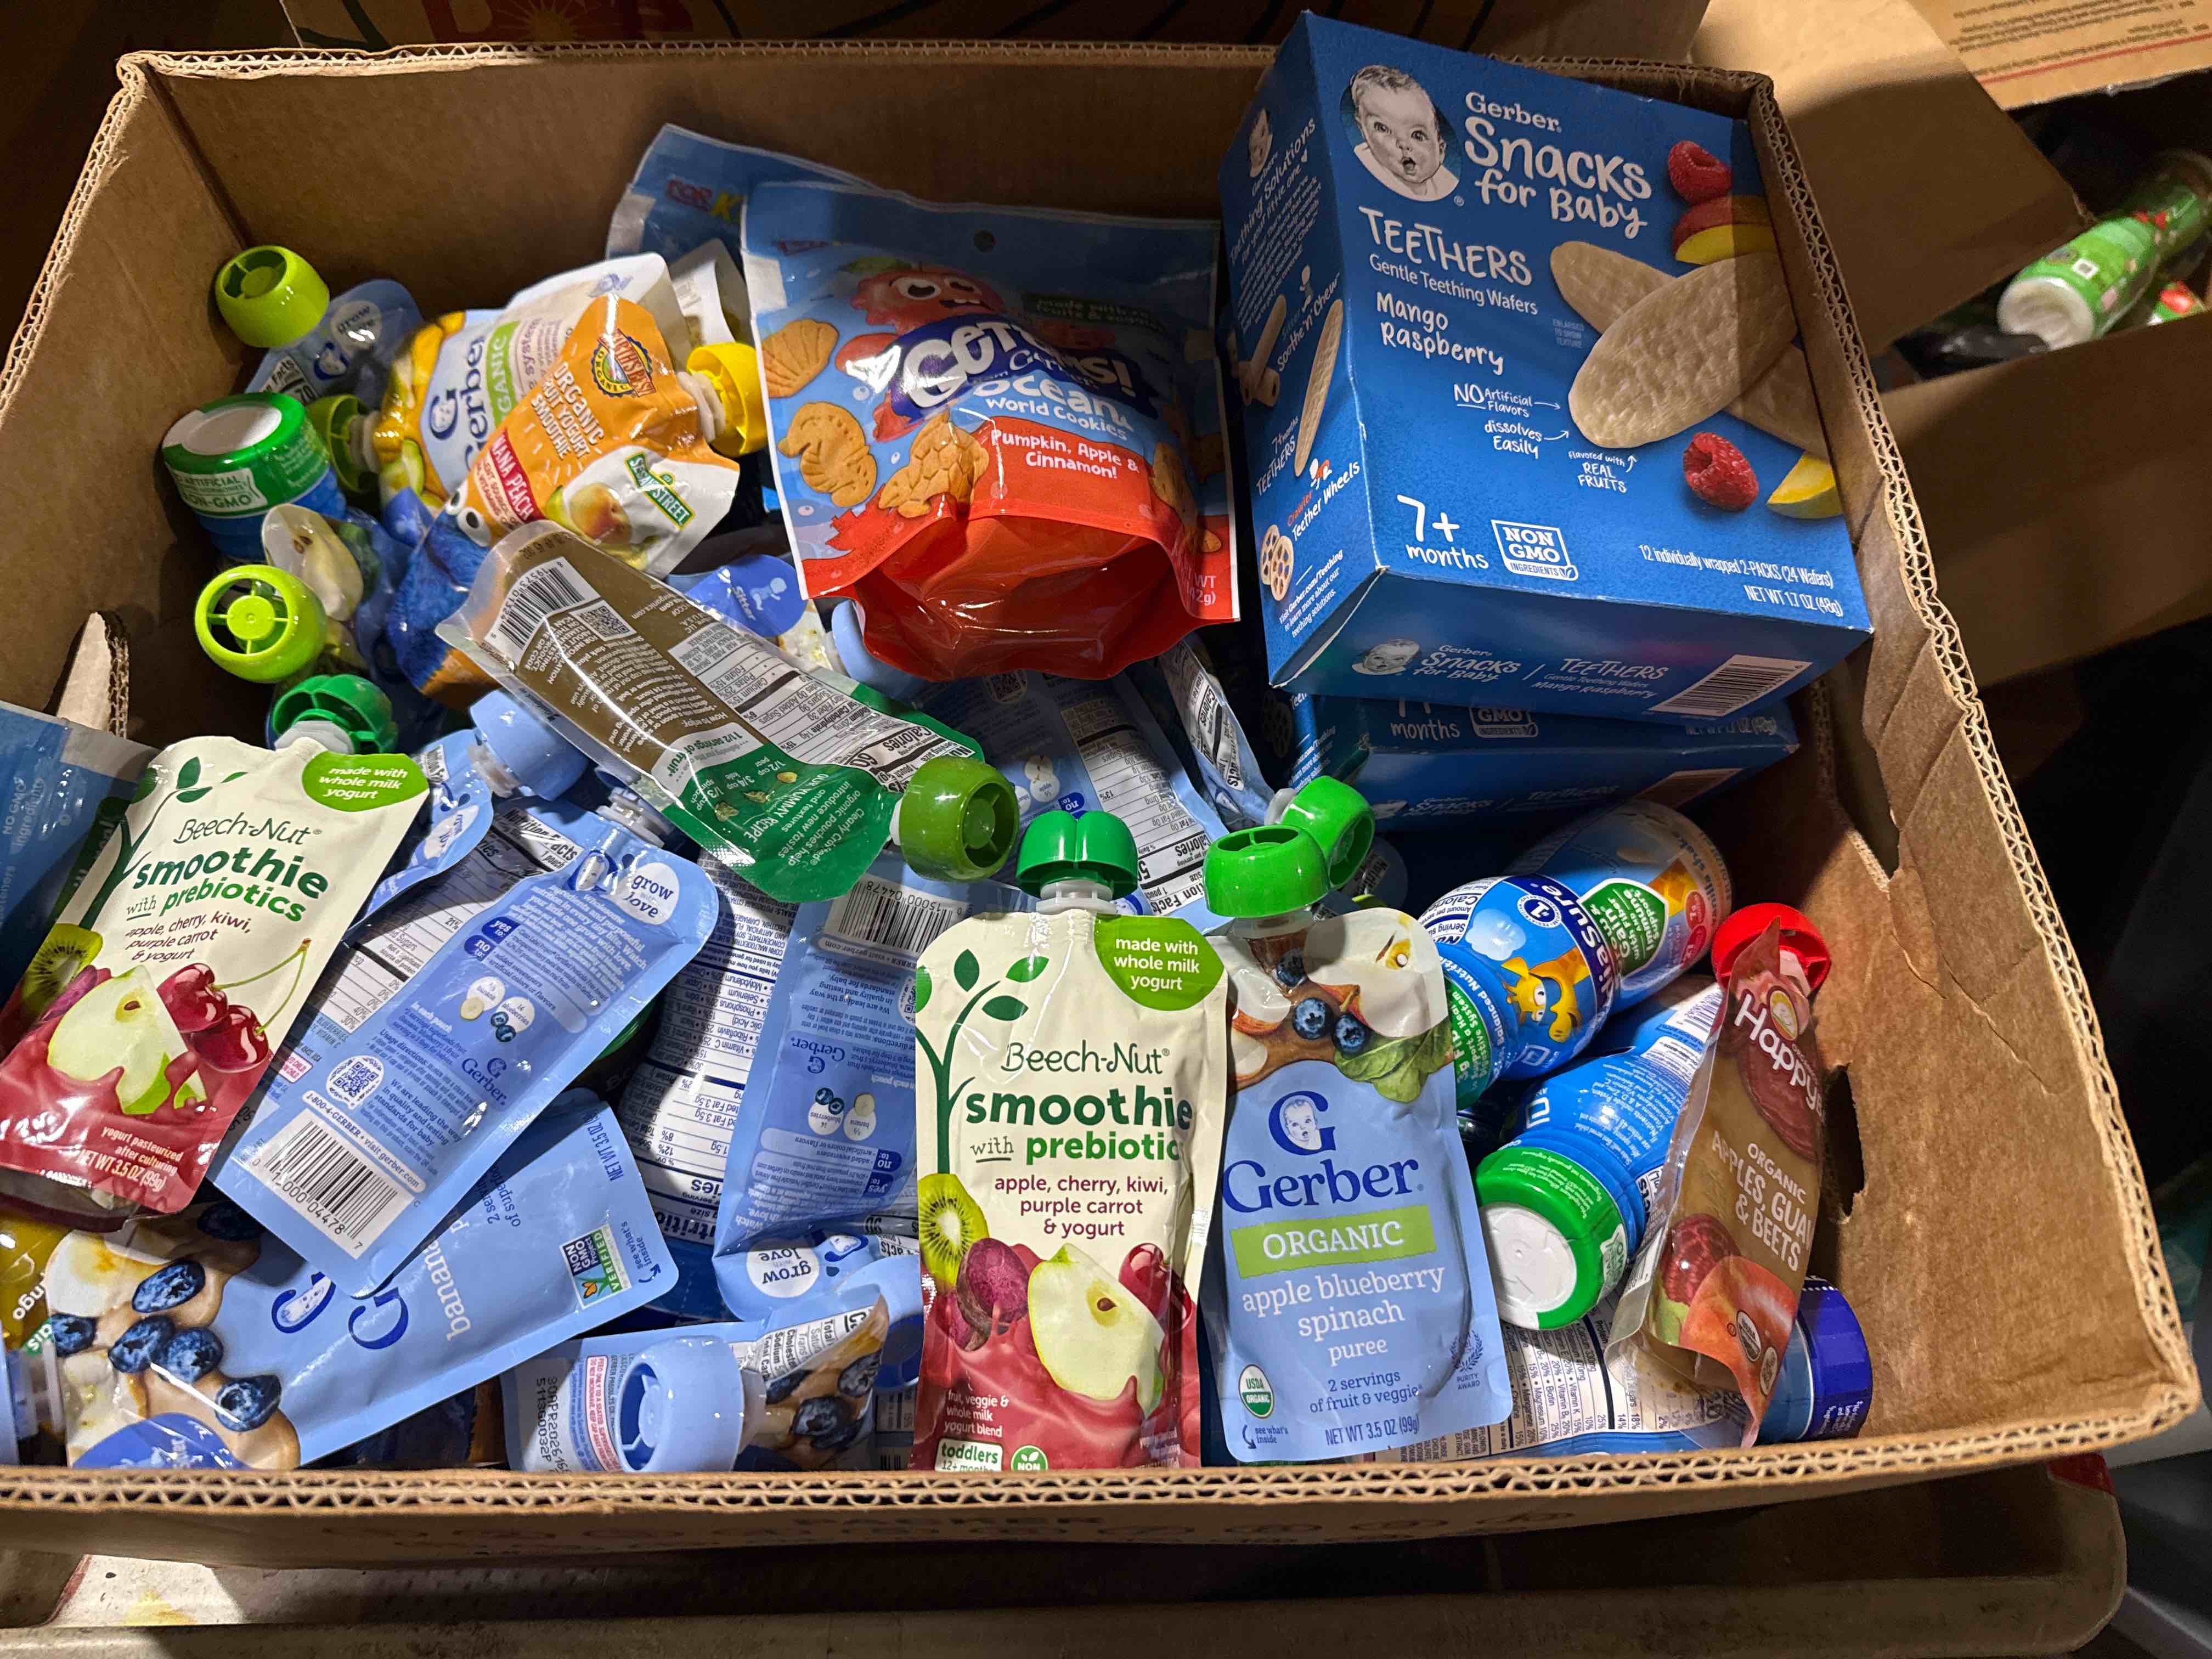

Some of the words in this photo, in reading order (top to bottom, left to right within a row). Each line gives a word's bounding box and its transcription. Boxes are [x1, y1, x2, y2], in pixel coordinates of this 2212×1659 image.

[1475, 167, 1537, 207] for
[1550, 187, 1647, 239] Baby
[1358, 206, 1532, 286] TEETHERS
[1369, 253, 1418, 285] Gentle
[1420, 271, 1484, 307] Teething
[1486, 290, 1538, 315] Wafers
[1376, 292, 1449, 332] Mango
[1380, 320, 1504, 376] Raspberry
[1454, 384, 1485, 404] NO
[1484, 388, 1533, 407] Artificial
[1488, 401, 1530, 417] Flavors
[531, 393, 571, 460] SMOOTHIE
[557, 405, 592, 460] YOGURT
[1053, 406, 1127, 442] Cookies
[1485, 420, 1542, 442] dissolves
[991, 430, 1071, 454] Pumpkin,
[1077, 442, 1121, 467] Apple
[1126, 458, 1140, 473] &
[1493, 436, 1539, 459] Easily
[1568, 451, 1603, 460] flavored
[1605, 456, 1625, 466] with
[1025, 451, 1118, 479] Cinnamon!
[1582, 462, 1616, 479] REAL
[506, 475, 534, 520] PEACH
[1577, 475, 1628, 493] FRUITS
[652, 484, 689, 526] STREET
[1292, 499, 1322, 542] Teether
[1323, 461, 1361, 505] Wheels
[1397, 494, 1460, 543] 7+
[1504, 526, 1555, 548] NON
[1405, 543, 1489, 570] months
[1511, 543, 1561, 564] GMO
[1638, 544, 1654, 561] 12
[1654, 548, 1702, 571] individually
[1703, 557, 1739, 574] wrapped
[1740, 560, 1783, 580] 2-PACKS
[1781, 566, 1799, 583] (24
[1799, 568, 1835, 589] Wafers)
[1510, 562, 1560, 577] INGREDIENTS
[1744, 585, 1768, 602] NET
[1766, 588, 1785, 604] WT
[1784, 591, 1799, 607] 1.7
[1799, 594, 1816, 610] OZ
[1815, 596, 1844, 618] (48g)
[1559, 658, 1670, 681] TEETHERS
[1390, 720, 1460, 742] months
[319, 776, 366, 786] whole
[369, 778, 402, 789] milk
[330, 767, 370, 776] made
[373, 768, 408, 778] with
[324, 788, 377, 800] yogurt
[816, 781, 853, 815] introduce
[834, 789, 861, 817] organic
[802, 814, 820, 832] new
[805, 814, 837, 848] pouches
[839, 808, 865, 835] Clearly
[778, 831, 805, 859] tastes
[788, 849, 811, 866] help
[132, 846, 330, 900] smoothie
[127, 898, 157, 916] with
[160, 878, 308, 923] prebiotics
[630, 874, 675, 901] grow
[623, 891, 659, 918] love
[168, 913, 207, 935] cherry,
[210, 911, 252, 935] kiwi,
[490, 918, 512, 932] yes
[127, 935, 175, 951] purple
[177, 928, 219, 948] carrot
[475, 939, 492, 952] no
[1115, 938, 1161, 953] made
[1164, 939, 1199, 955] with
[131, 950, 145, 962] &
[143, 948, 195, 963] yogurt
[1114, 955, 1164, 970] whole
[1167, 958, 1200, 974] milk
[1130, 973, 1183, 991] yogurt
[1477, 990, 1506, 1046] Balanced
[965, 1085, 1193, 1131] smoothie
[101, 1126, 133, 1143] yogurt
[131, 1136, 184, 1162] pasteurized
[304, 1092, 361, 1138] 1-800-4-GERBER
[364, 1138, 382, 1156] visit
[378, 1150, 420, 1188] gerber.com
[970, 1136, 1014, 1156] with
[1026, 1130, 1186, 1166] prebiotic
[78, 1148, 99, 1169] NET
[95, 1153, 116, 1172] WT
[111, 1159, 131, 1177] 3.5
[127, 1165, 145, 1181] OZ
[139, 1170, 167, 1192] (99g)
[115, 1146, 139, 1160] after
[139, 1154, 178, 1176] culturing
[1712, 1130, 1767, 1210] APPLES,
[1747, 1143, 1808, 1205] ORGANIC
[994, 1175, 1052, 1194] apple,
[1057, 1176, 1121, 1195] cherry,
[1126, 1176, 1169, 1195] kiwi,
[308, 1200, 346, 1235] 04478
[1020, 1197, 1081, 1216] purple
[1086, 1199, 1143, 1214] carrot
[1043, 1218, 1057, 1235] &
[1061, 1221, 1125, 1239] yogurt
[1262, 1220, 1405, 1261] ORGANIC
[1735, 1193, 1749, 1225] &
[1751, 1207, 1801, 1272] BEETS
[566, 1246, 582, 1273] NON
[575, 1240, 591, 1270] GMO
[593, 1232, 619, 1293] VERIFIED
[1242, 1279, 1312, 1318] apple
[1317, 1265, 1446, 1301] blueberry
[1297, 1300, 1405, 1342] spinach
[1328, 1338, 1388, 1367] puree
[1246, 1378, 1264, 1390] USDA
[1328, 1379, 1338, 1392] 2
[1340, 1370, 1402, 1389] servings
[1457, 1374, 1479, 1382] PURITY
[1457, 1380, 1481, 1390] AWARD
[946, 1406, 972, 1418] whole
[973, 1410, 994, 1421] milk
[966, 1395, 998, 1408] veggie
[1000, 1395, 1009, 1407] &
[1310, 1400, 1324, 1414] of
[1325, 1393, 1360, 1413] fruit
[1362, 1393, 1372, 1405] &
[943, 1421, 975, 1434] yogurt
[977, 1425, 1003, 1437] blend
[1325, 1427, 1344, 1446] NET
[1345, 1425, 1365, 1443] WT
[1367, 1422, 1383, 1440] 3.5
[1384, 1418, 1398, 1436] OZ
[1398, 1414, 1420, 1435] (99g)
[1631, 1413, 1640, 1430] 18%
[941, 1442, 998, 1464] toddlers
[1018, 1462, 1041, 1471] NON
